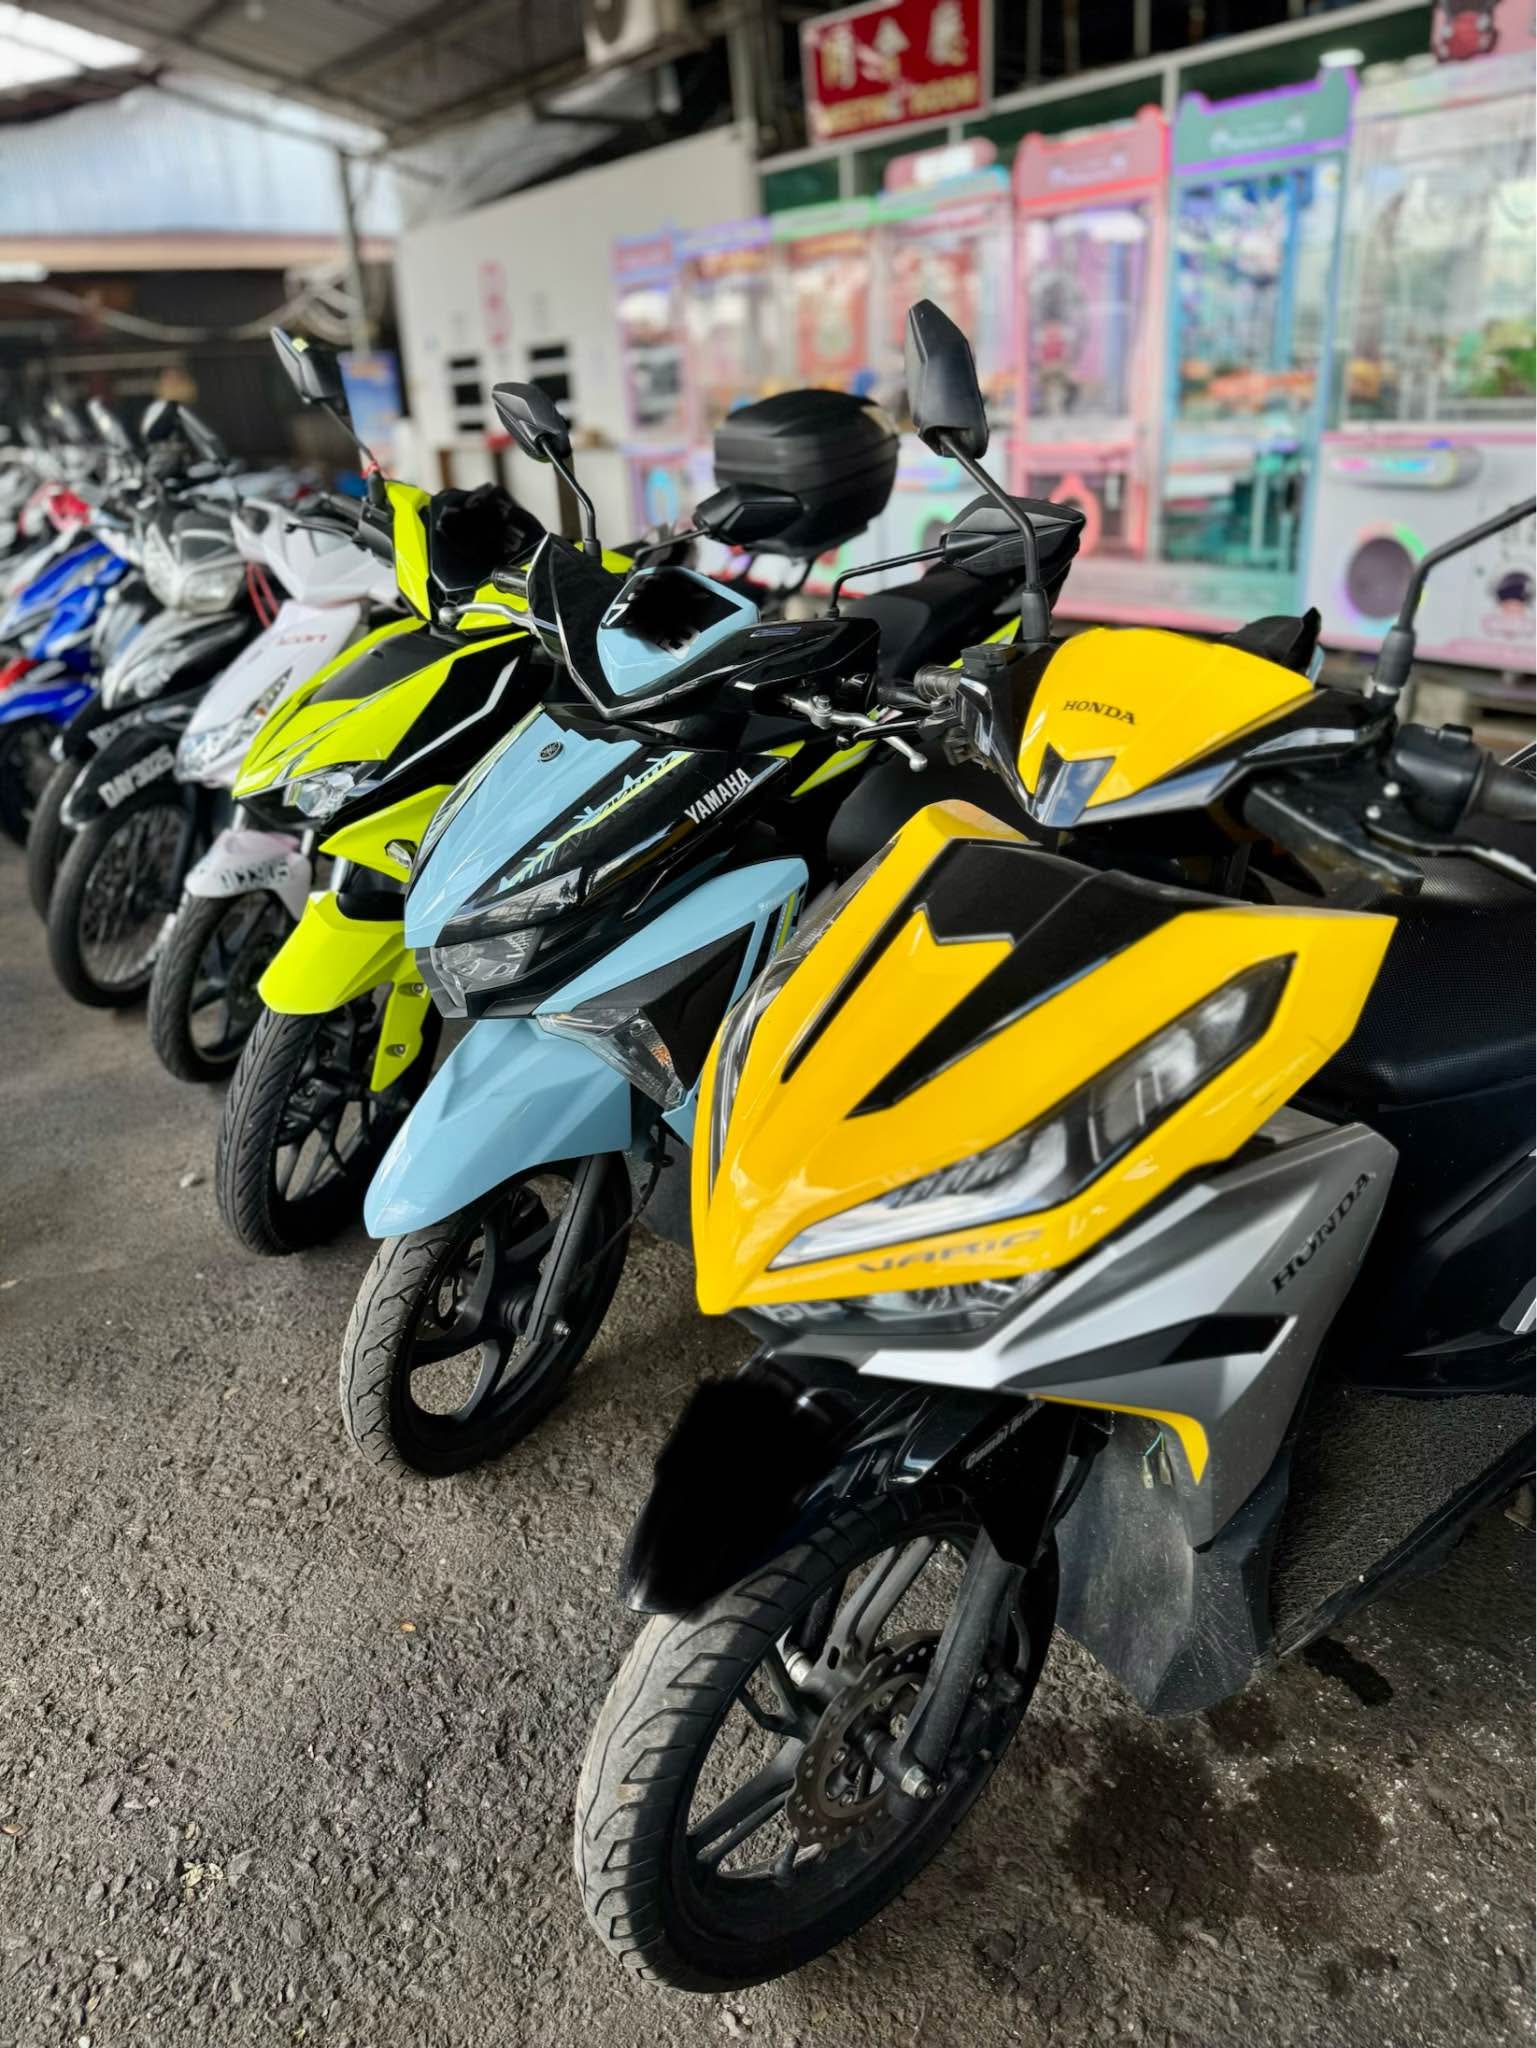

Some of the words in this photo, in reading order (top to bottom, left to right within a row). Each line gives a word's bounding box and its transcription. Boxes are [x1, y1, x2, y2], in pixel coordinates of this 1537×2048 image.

[1062, 700, 1136, 725] HONDA
[684, 767, 751, 825] YAMAHA
[1271, 1172, 1370, 1295] HONDA
